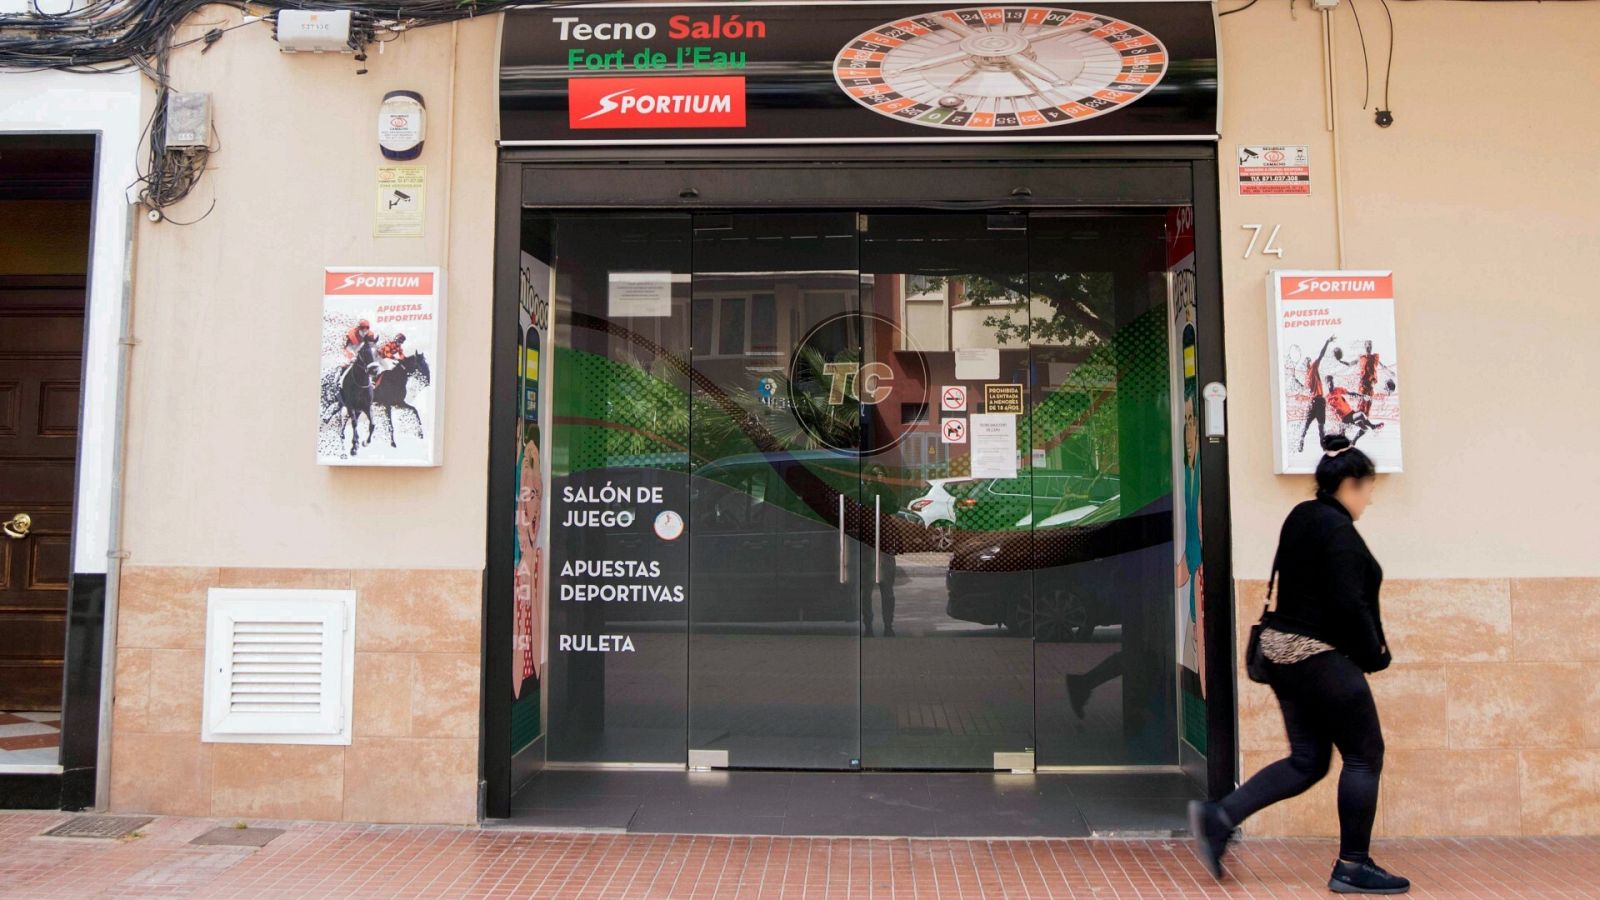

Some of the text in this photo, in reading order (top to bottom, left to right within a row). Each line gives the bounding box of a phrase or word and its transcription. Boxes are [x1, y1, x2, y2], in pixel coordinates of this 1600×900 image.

[961, 13, 980, 21] 24
[1005, 11, 1022, 20] 13
[1032, 10, 1041, 20] 1
[1047, 13, 1066, 22] 00
[552, 14, 767, 41] Tecno Salón
[567, 46, 747, 71] Fort de l'Eau
[577, 88, 731, 121] SPORTIUM
[1048, 111, 1059, 119] 4
[1241, 224, 1283, 259] 74
[332, 273, 420, 291] SPORTIUM
[1287, 278, 1375, 296] SPORTIUM
[376, 303, 423, 313] APUESTAS
[1283, 308, 1330, 318] APUESTAS
[376, 313, 433, 323] DEPORTIVAS
[1284, 318, 1343, 329] DEPORTIVAS
[822, 361, 895, 406] TC
[562, 481, 664, 503] SALÓN DE
[562, 510, 633, 528] JUEGO
[560, 560, 661, 578] APUESTAS
[560, 584, 685, 602] DEPORTIVAS
[559, 634, 636, 652] RULETA
